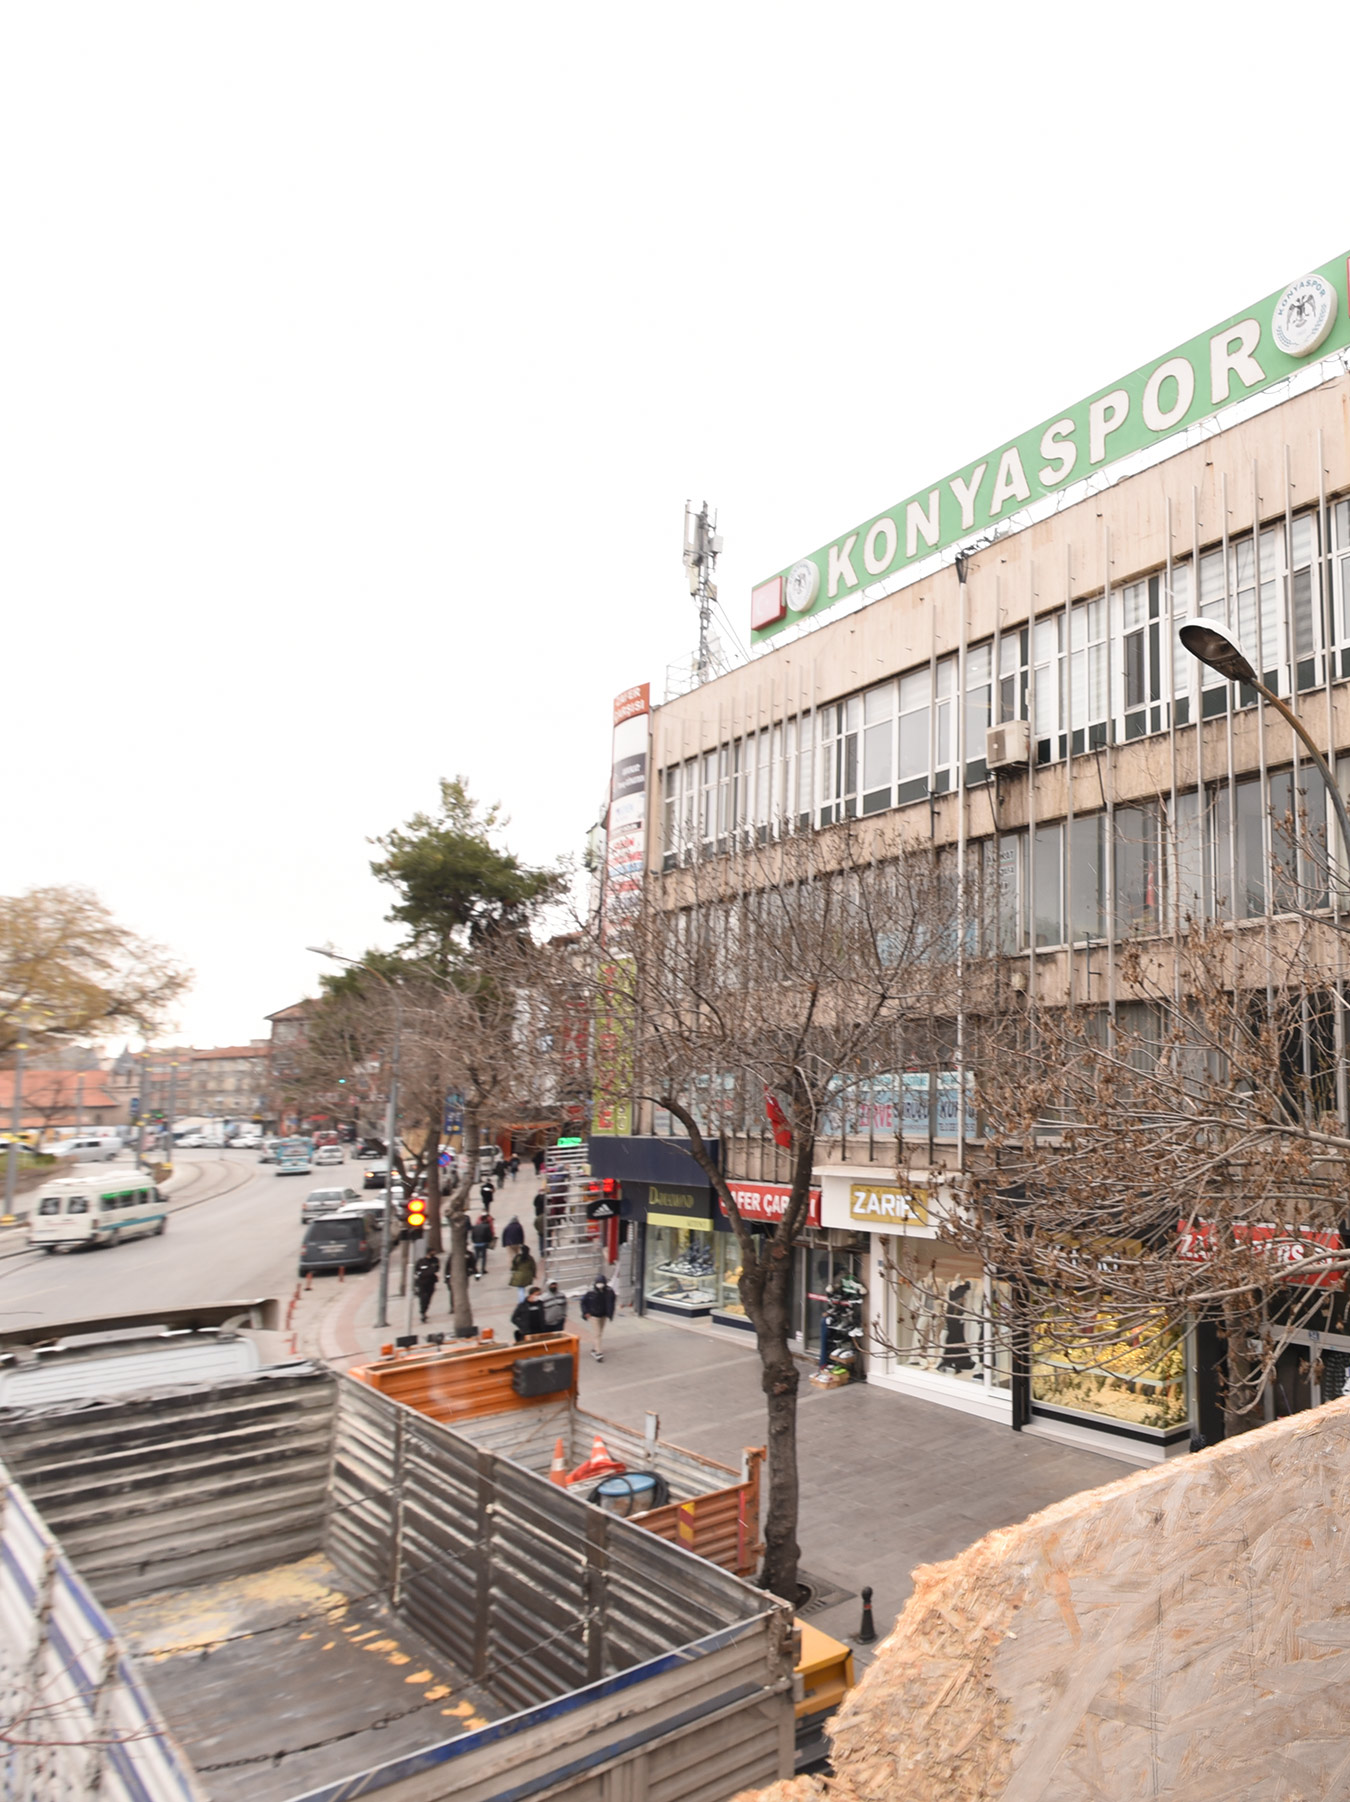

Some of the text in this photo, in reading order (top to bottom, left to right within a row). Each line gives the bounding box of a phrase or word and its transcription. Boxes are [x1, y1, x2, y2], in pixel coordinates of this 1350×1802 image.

[1278, 280, 1326, 316] KONYASPOR
[827, 317, 1267, 598] KONYASPOR
[720, 1190, 816, 1218] AFER ÇARI
